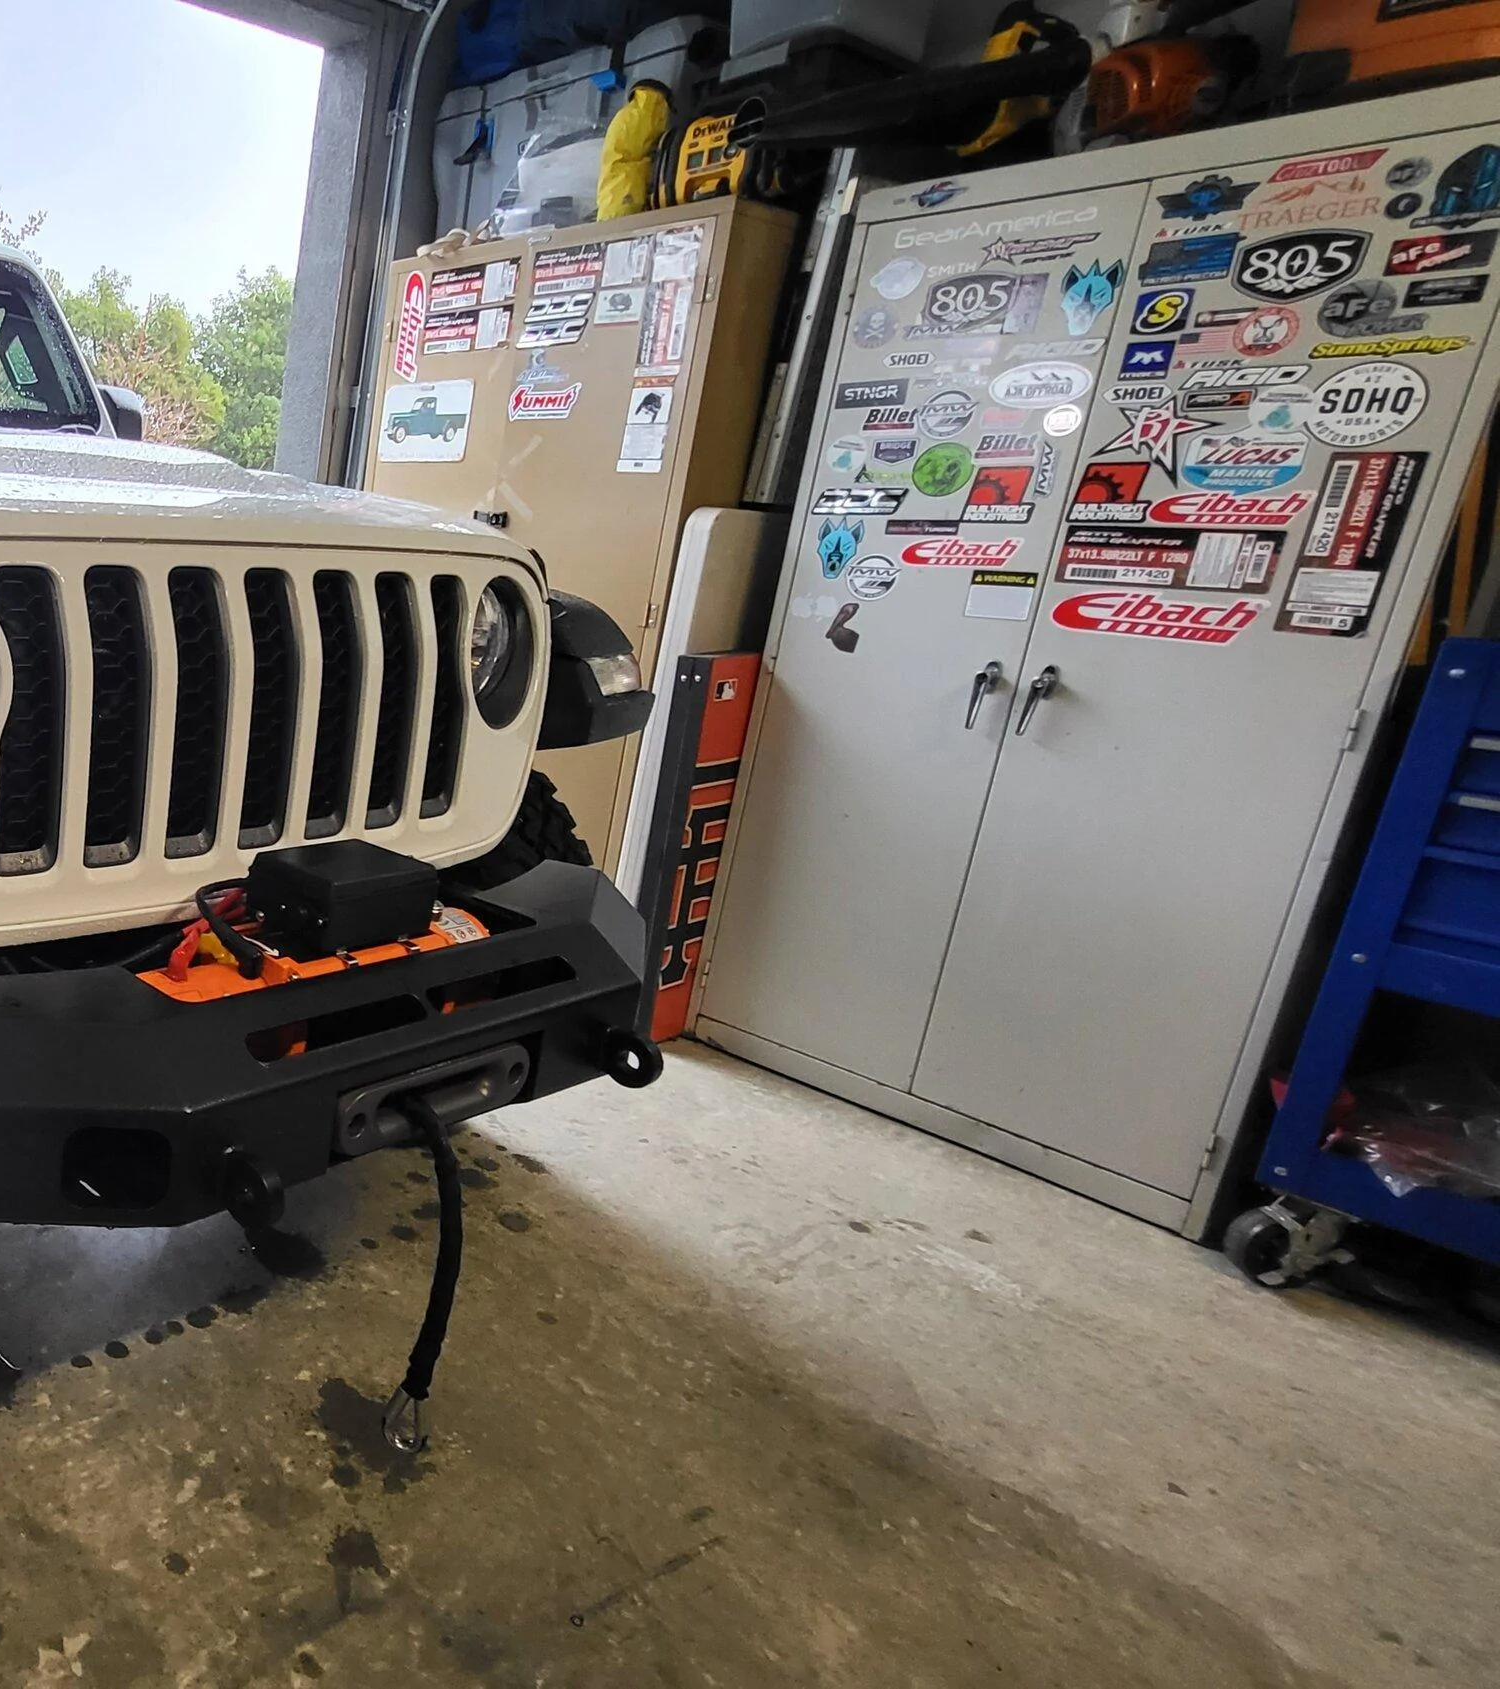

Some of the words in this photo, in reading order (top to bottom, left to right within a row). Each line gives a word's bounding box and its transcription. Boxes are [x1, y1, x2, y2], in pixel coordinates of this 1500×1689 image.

[1238, 197, 1381, 230] TRAEGER
[894, 206, 1098, 249] GearAmerica
[927, 262, 977, 278] SMITH
[1242, 239, 1357, 284] 805
[931, 280, 1011, 315] 805
[1311, 336, 1470, 358] SumoSprings
[889, 353, 929, 366] SHOEI
[1181, 364, 1311, 389] RIGID
[844, 385, 899, 400] STNGR
[1112, 387, 1164, 400] SHOEI
[1319, 387, 1414, 415] SDHQ
[865, 408, 918, 423] Billet
[1344, 418, 1372, 426] USA
[977, 433, 1037, 450] Billet
[1314, 420, 1403, 443] MOTORSPORTS
[1196, 448, 1299, 465] LUCAS
[1209, 469, 1280, 478] MARINE
[1150, 493, 1309, 524] Eibach
[1315, 512, 1340, 553] 217420
[902, 538, 1019, 564] Eibach
[1121, 568, 1170, 579] 217420
[1052, 593, 1259, 636] Eibach
